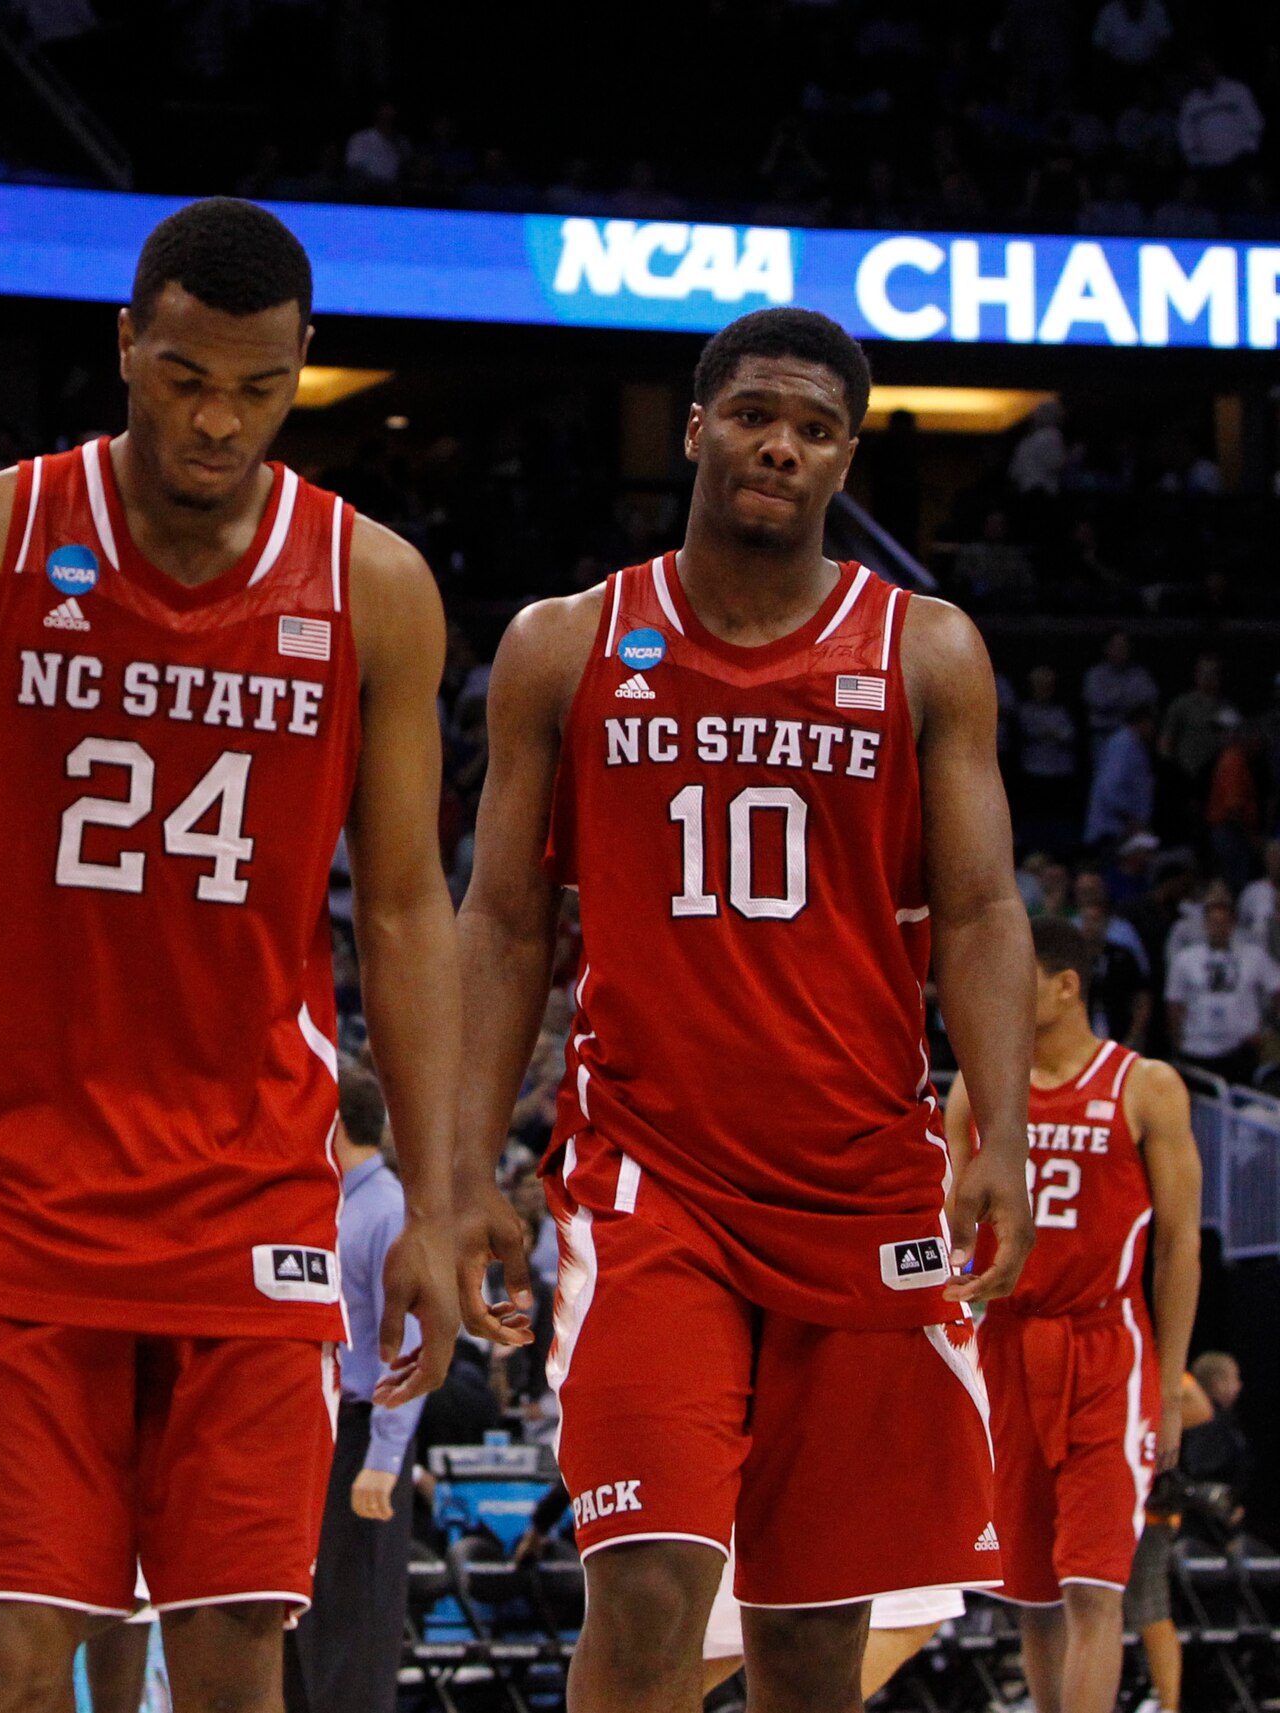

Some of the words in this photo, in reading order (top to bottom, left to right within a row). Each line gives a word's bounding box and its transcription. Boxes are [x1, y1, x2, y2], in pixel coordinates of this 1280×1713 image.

[554, 218, 793, 303] NCAA
[52, 565, 97, 585] NCAA
[43, 616, 91, 632] adidas
[623, 646, 663, 660] NCAA
[17, 650, 103, 710] NC
[122, 661, 324, 737] STATE
[615, 689, 656, 700] adidas
[604, 716, 679, 766] NC
[695, 715, 881, 780] STATE
[55, 737, 255, 904] 24
[668, 784, 809, 920] 10
[573, 1479, 643, 1530] PACK
